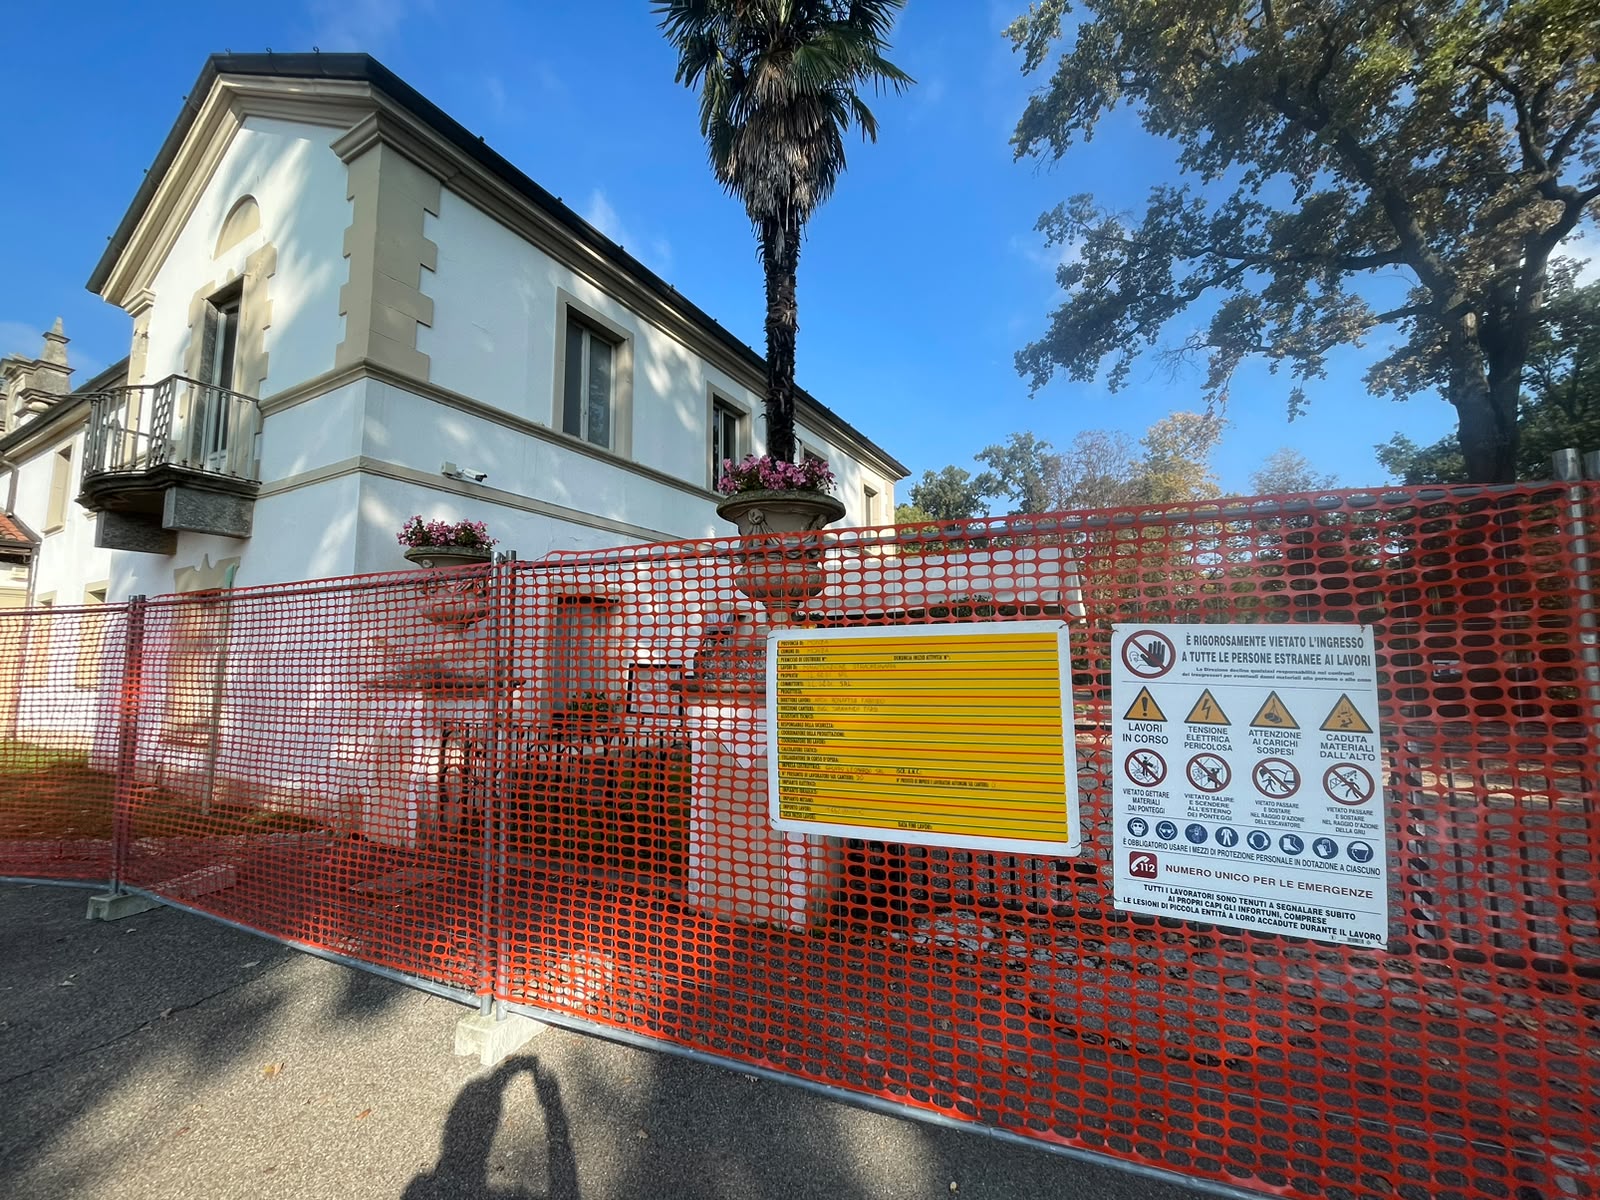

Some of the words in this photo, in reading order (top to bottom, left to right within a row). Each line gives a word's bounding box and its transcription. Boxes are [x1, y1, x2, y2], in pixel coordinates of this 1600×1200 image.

[1186, 632, 1191, 645] È
[1194, 635, 1266, 646] RIGOROSAMENTE
[1269, 636, 1305, 647] VIETATO
[1309, 637, 1364, 648] L'INGRESSO
[1182, 652, 1187, 662] A
[1190, 652, 1216, 662] TUTTE
[1219, 652, 1229, 662] LE
[1232, 652, 1271, 663] PERSONE
[1275, 653, 1321, 664] ESTRANEE
[1325, 654, 1333, 665] AI
[1337, 655, 1370, 666] LAVORI
[1128, 723, 1162, 732] LAVORI
[1188, 726, 1228, 735] TENSIONE
[1123, 734, 1132, 742] IN
[1135, 735, 1169, 744] CORSO
[1186, 734, 1230, 743] ELETTRICA
[1249, 730, 1301, 739] ATTENZIONE
[1326, 734, 1367, 743] CADUTA
[1184, 742, 1232, 751] PERICOLOSA
[1263, 739, 1298, 747] CARICHI
[1320, 742, 1374, 752] MATERIALI
[1257, 747, 1294, 756] SOSPESI
[1320, 751, 1375, 761] DALL'ALTO
[1123, 788, 1144, 796] VIETATO
[1145, 790, 1169, 798] GETTARE
[1133, 797, 1160, 805] MATERIALI
[1138, 805, 1165, 814] PONTEGGI
[1187, 806, 1231, 814] ALL'ESTERNO
[1199, 813, 1232, 821] PONTEGGI
[1255, 819, 1300, 828] DELL'ESCAVATORE
[1128, 839, 1168, 849] OBBLIGATORIO
[1169, 843, 1188, 852] USARE
[1194, 846, 1209, 854] MEZZI
[1217, 849, 1254, 860] PROTEZIONE
[1256, 853, 1293, 865] PERSONALE
[1303, 859, 1338, 870] DOTAZIONE
[1346, 864, 1380, 875] CIASCUNO
[1140, 863, 1155, 872] 112
[1166, 865, 1211, 877] NUMERO
[1215, 871, 1250, 882] UNICO
[1254, 875, 1276, 886] PER
[1280, 879, 1294, 888] LE
[1298, 882, 1373, 898] EMERGENZE
[1144, 884, 1164, 892] TUTTI
[1170, 888, 1214, 900] LAVORATORI
[1240, 897, 1267, 908] TENUTI
[1276, 902, 1322, 915] SEGNALARE
[1325, 910, 1356, 920] SUBITO
[1177, 896, 1203, 906] PROPRI
[1205, 900, 1222, 909] CAPI
[1224, 903, 1236, 911] GLI
[1238, 906, 1282, 919] INFORTUNI,
[1284, 912, 1327, 925] COMPRESE
[1123, 896, 1131, 904] LE
[1133, 898, 1160, 907] LESIONI
[1170, 903, 1199, 914] PICCOLA
[1202, 908, 1227, 918] ENTITÀ
[1235, 914, 1255, 922] LORO
[1258, 917, 1298, 929] ACCADUTE
[1300, 924, 1337, 935] DURANTE
[1349, 930, 1381, 941] LAVORO
